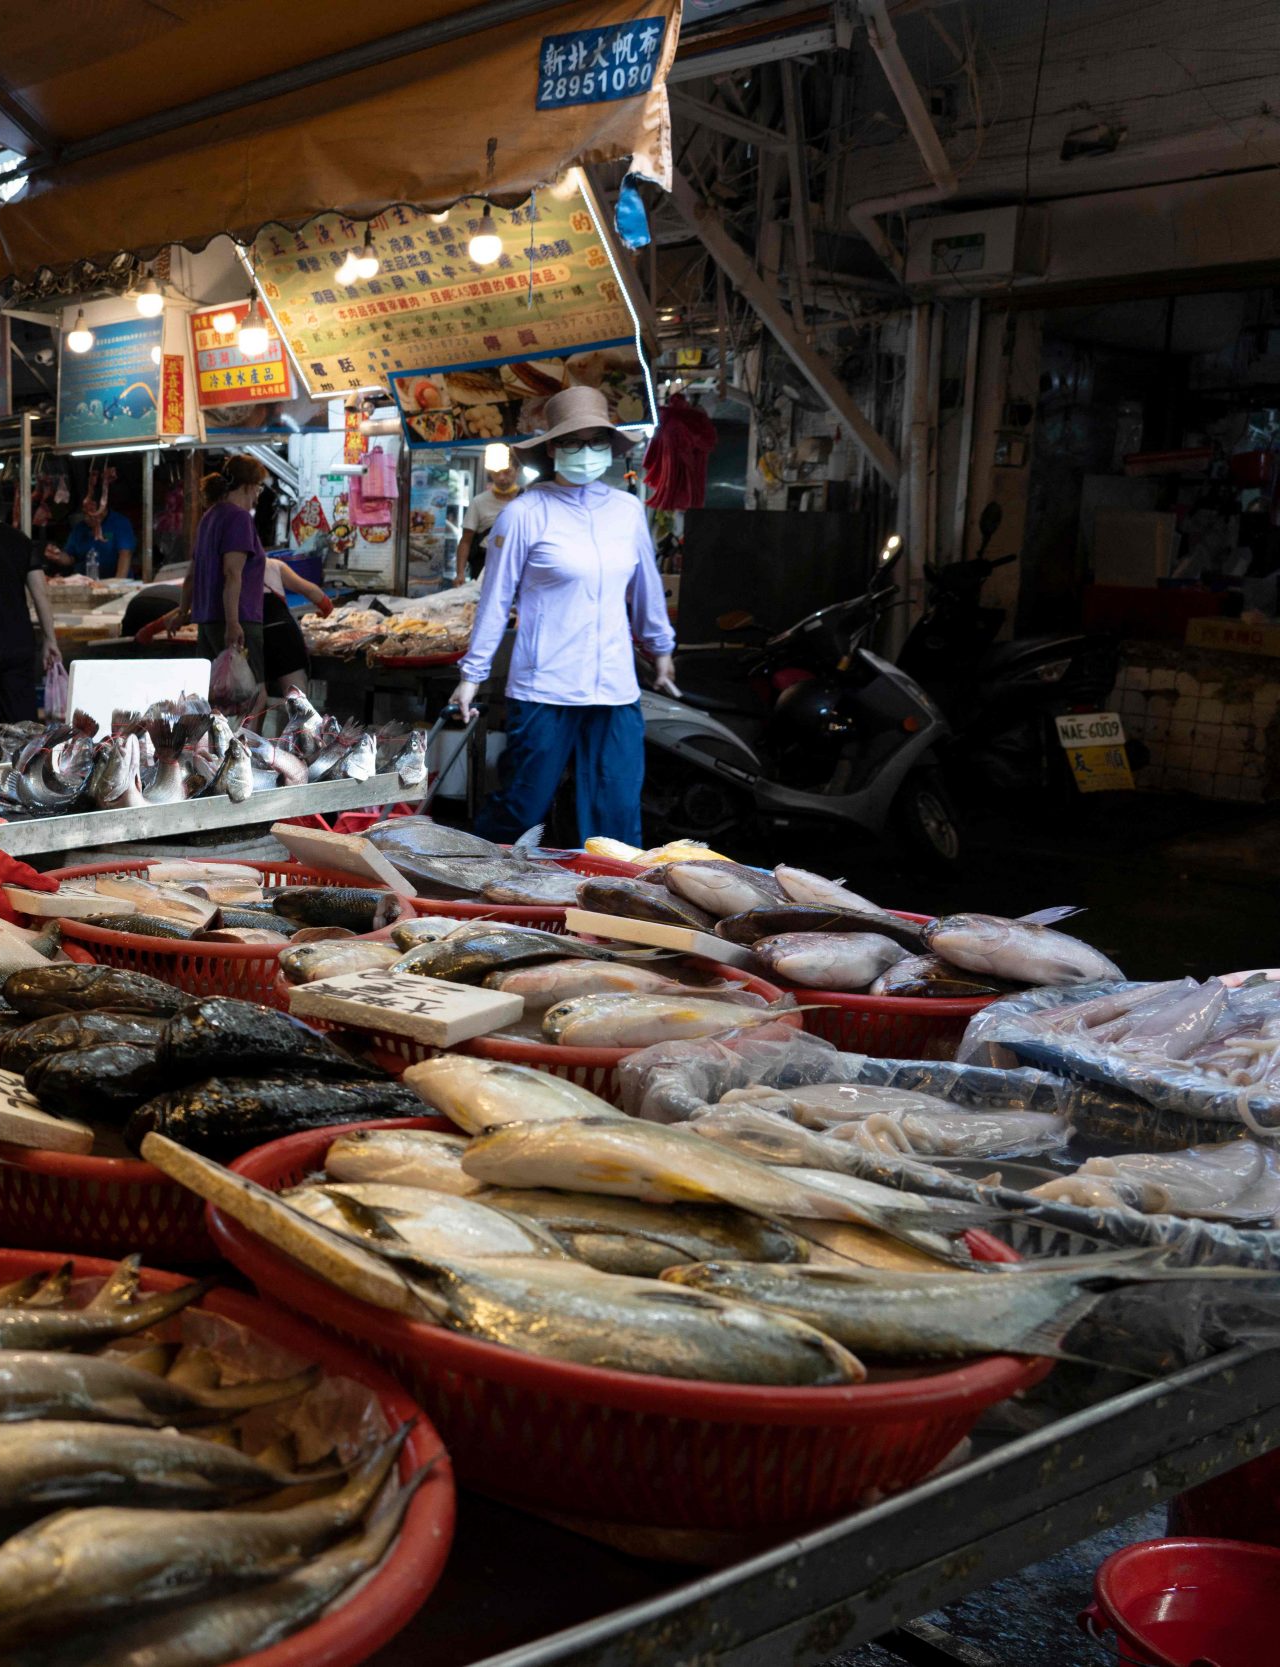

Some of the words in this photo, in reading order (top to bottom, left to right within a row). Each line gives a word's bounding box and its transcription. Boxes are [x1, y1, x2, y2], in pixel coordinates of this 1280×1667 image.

[543, 26, 660, 77] 新北大帆布
[541, 62, 652, 101] 28951080
[209, 367, 274, 388] 冷凍水產品
